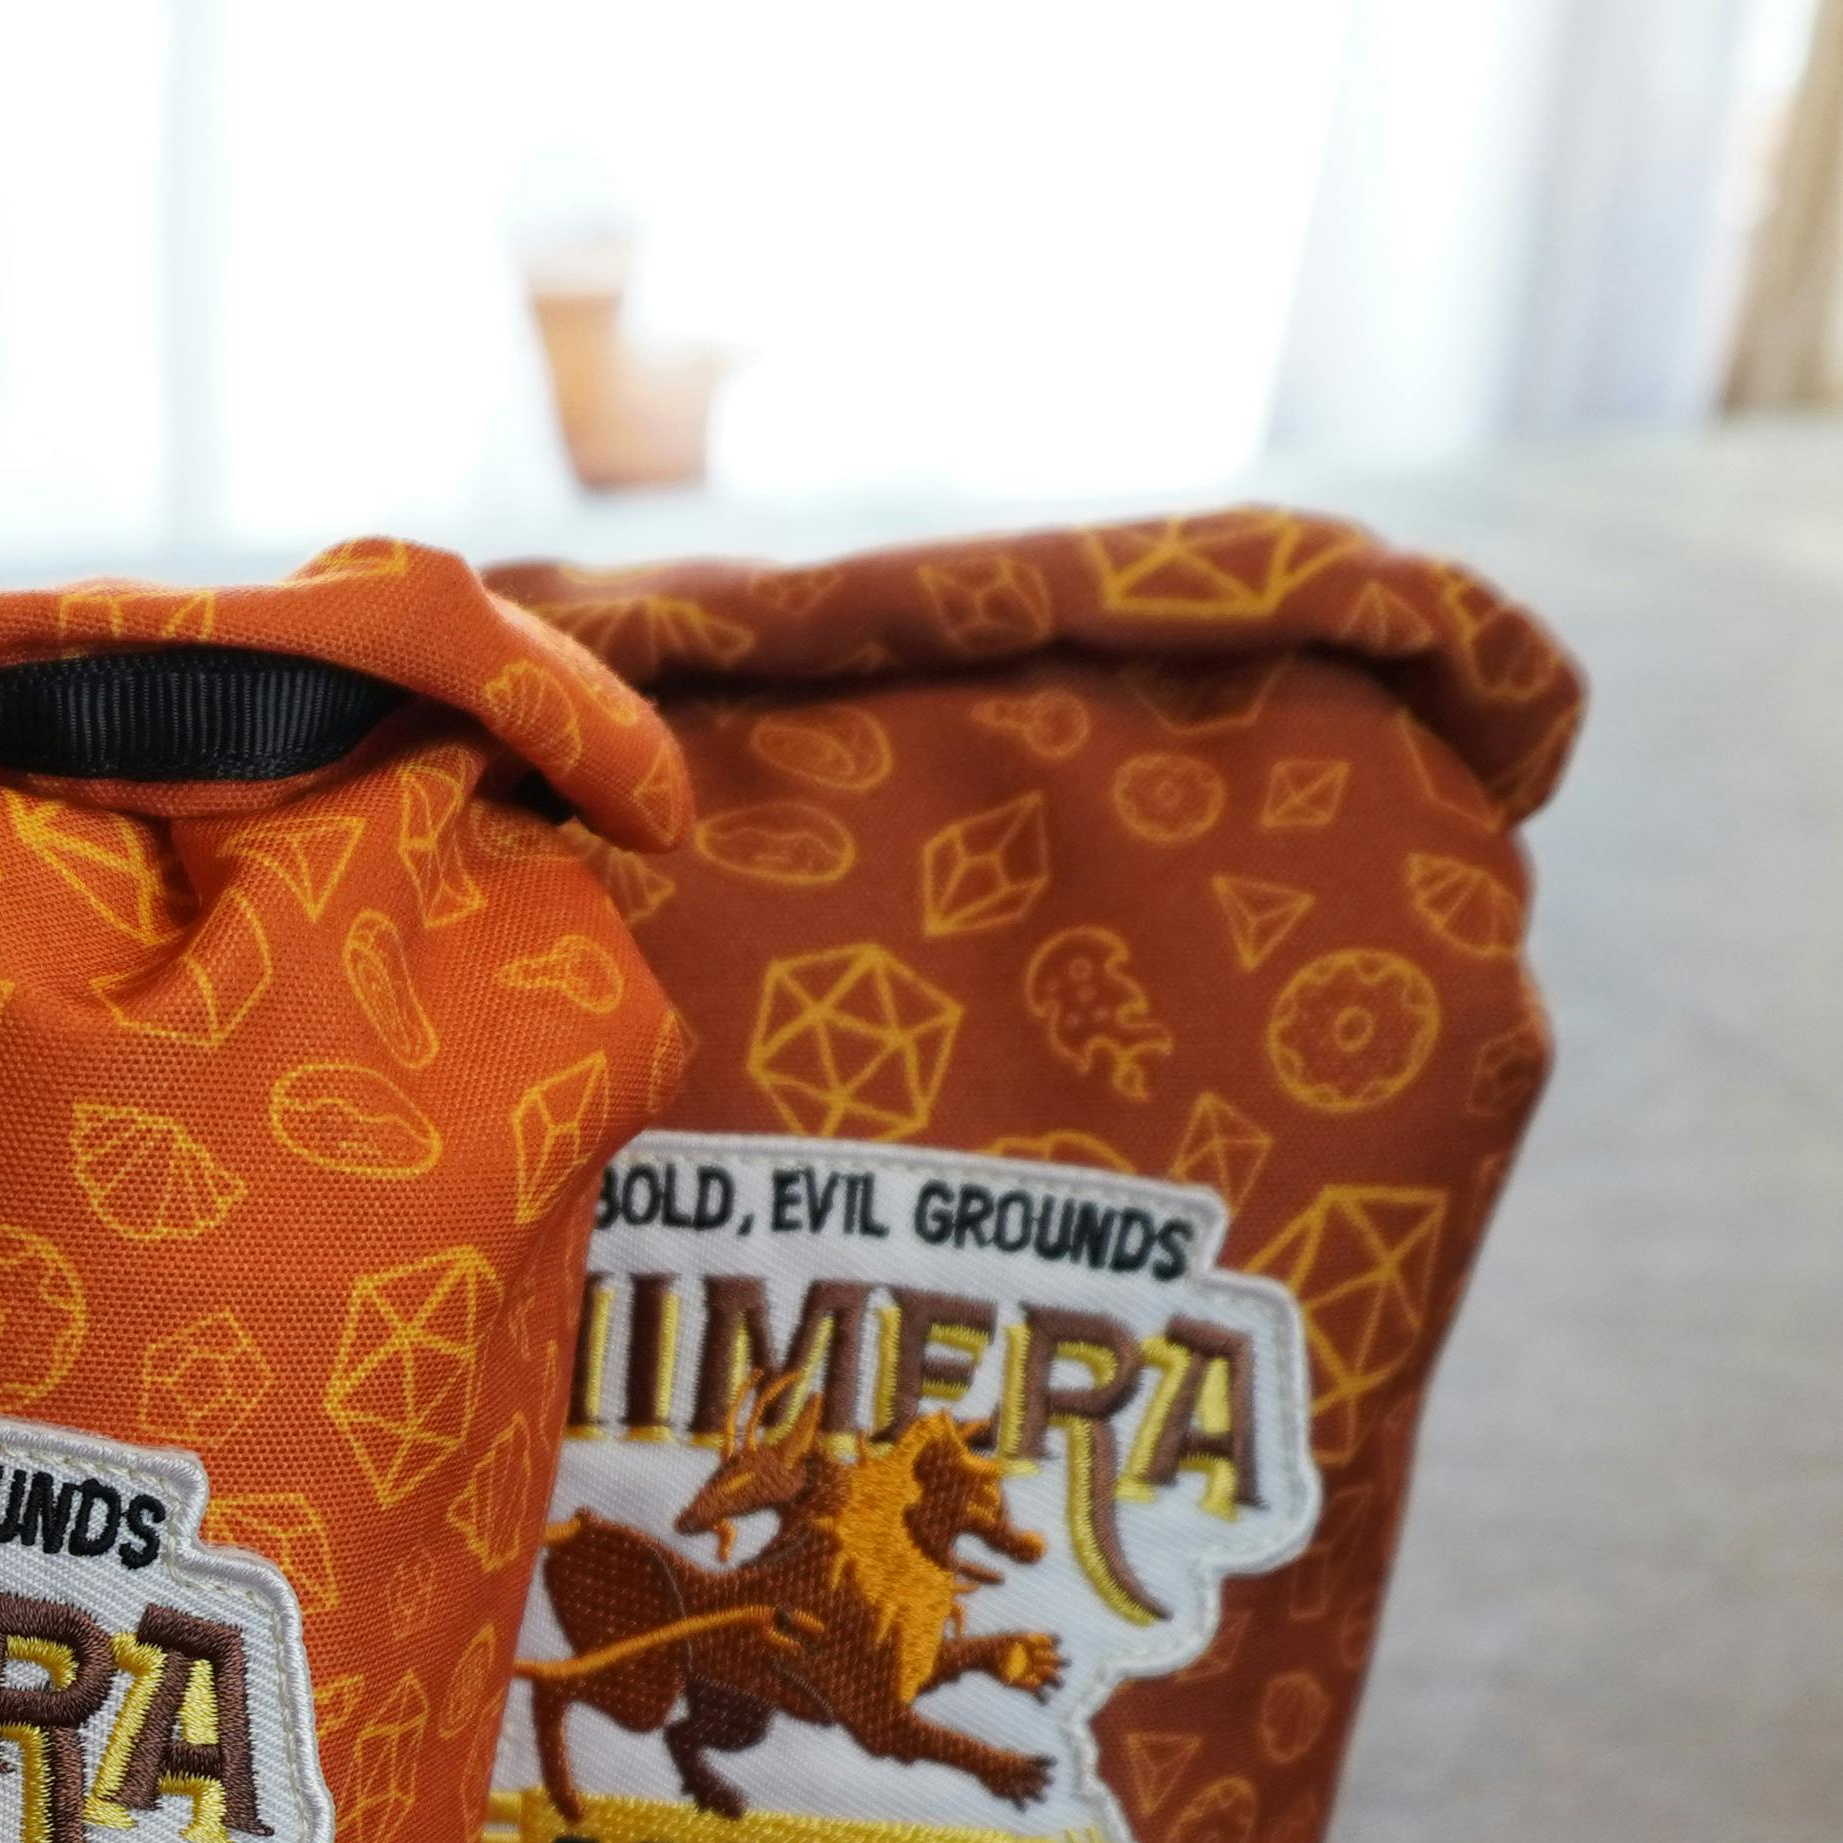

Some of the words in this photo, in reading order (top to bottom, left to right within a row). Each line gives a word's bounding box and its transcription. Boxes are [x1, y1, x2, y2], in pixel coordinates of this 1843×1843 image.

[771, 1169, 889, 1240] EVIL
[912, 1183, 1194, 1282] GROUNDS
[567, 1270, 1270, 1629] IMERA
